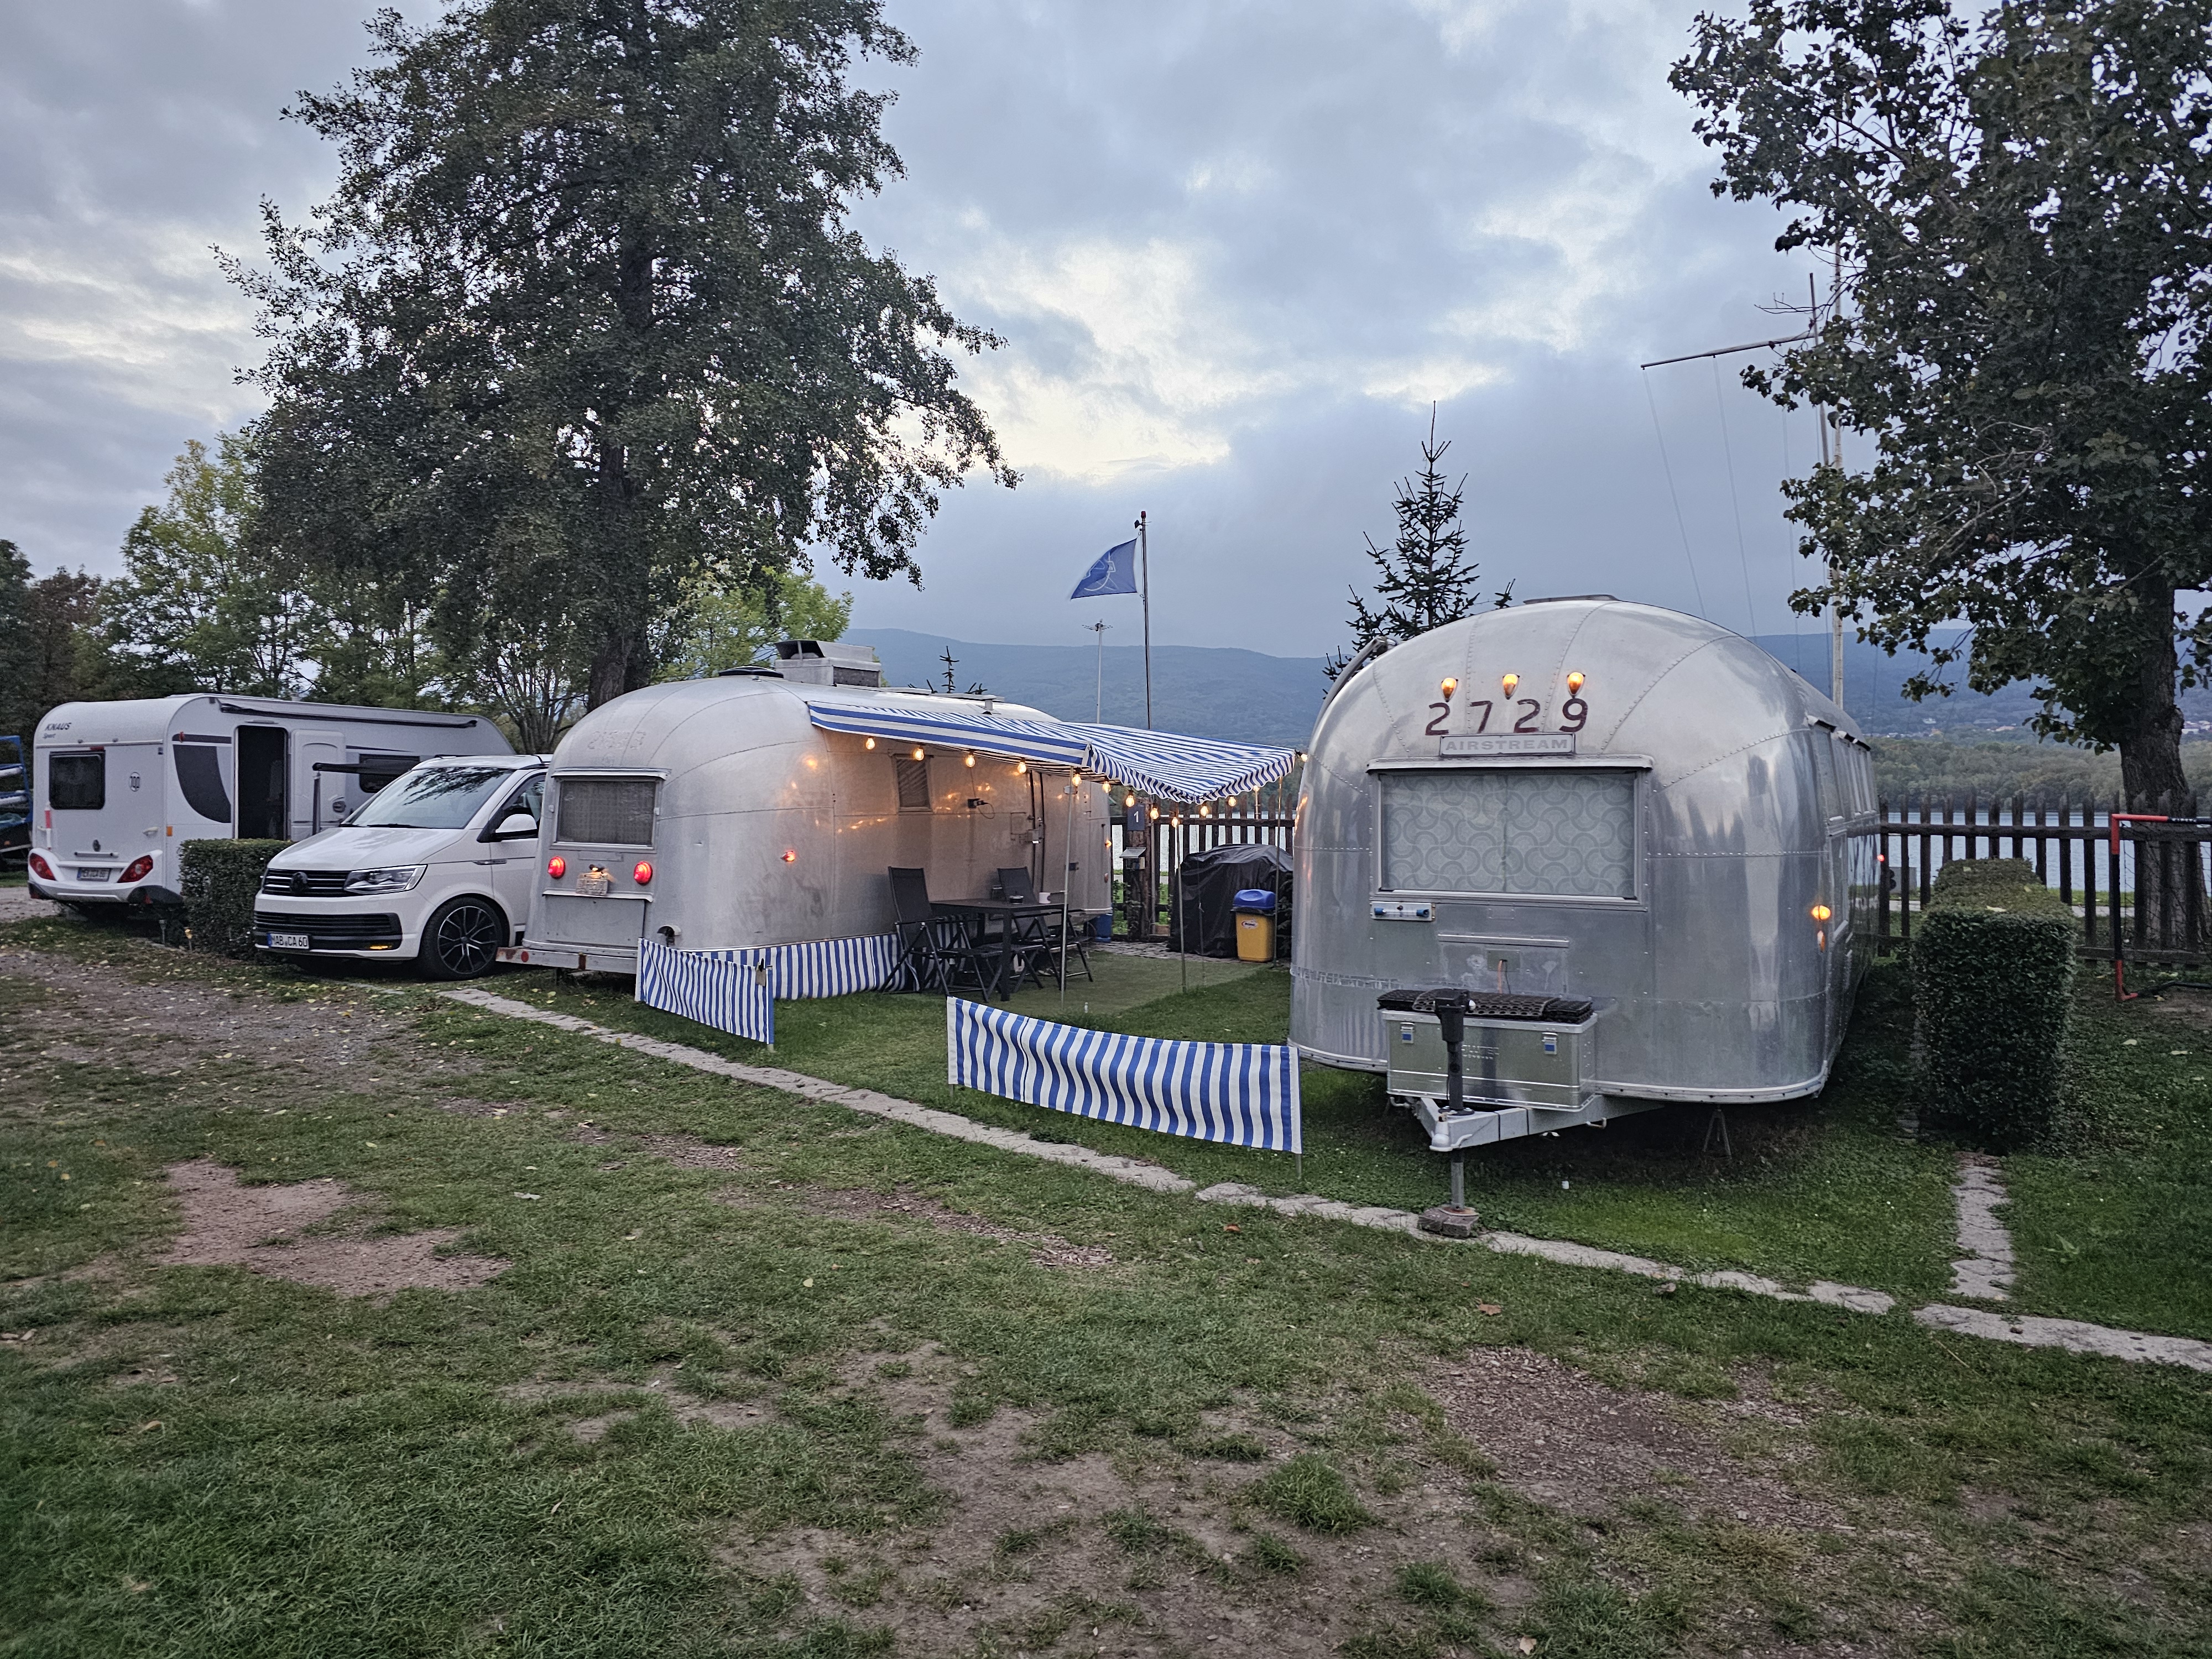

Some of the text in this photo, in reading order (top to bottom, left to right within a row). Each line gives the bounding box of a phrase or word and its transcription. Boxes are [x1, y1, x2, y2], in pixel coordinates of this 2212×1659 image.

[1425, 698, 1588, 735] 2729
[45, 722, 72, 731] KNAUS
[1445, 739, 1568, 751] AIRSTREAM
[1134, 811, 1139, 823] 1
